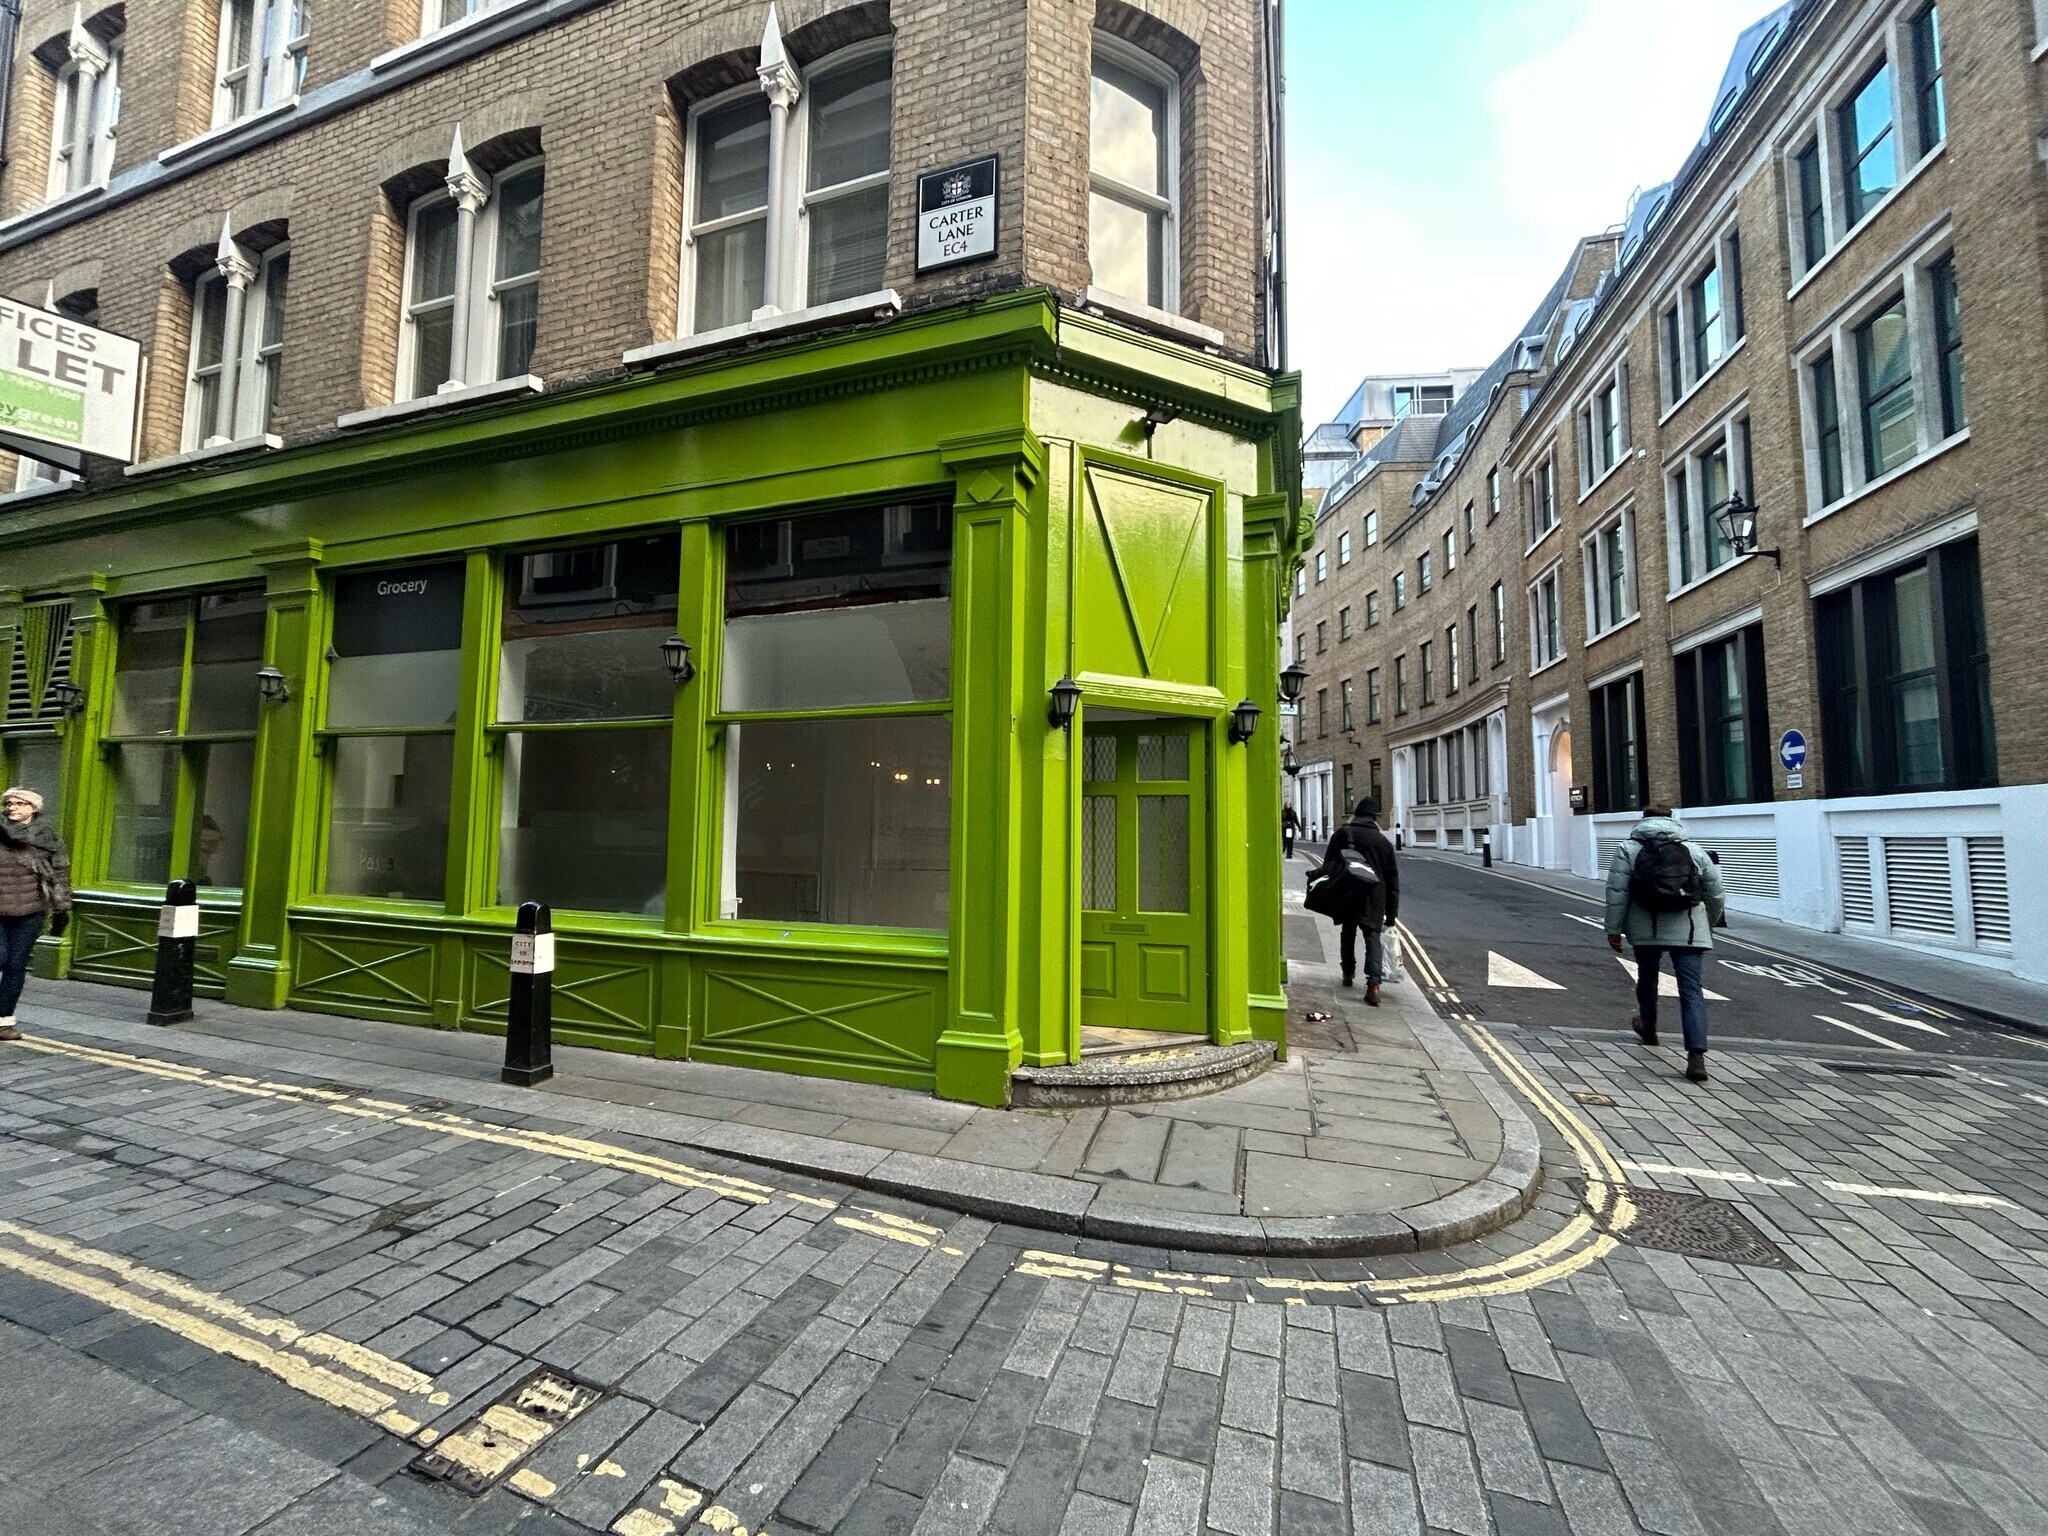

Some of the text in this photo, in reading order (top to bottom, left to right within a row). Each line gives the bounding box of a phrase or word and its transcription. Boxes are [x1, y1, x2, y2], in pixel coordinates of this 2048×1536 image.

[930, 206, 983, 229] CARTER
[938, 223, 974, 243] LANE
[943, 241, 967, 257] EC4
[17, 338, 126, 395] LET
[377, 580, 427, 595] Grocery
